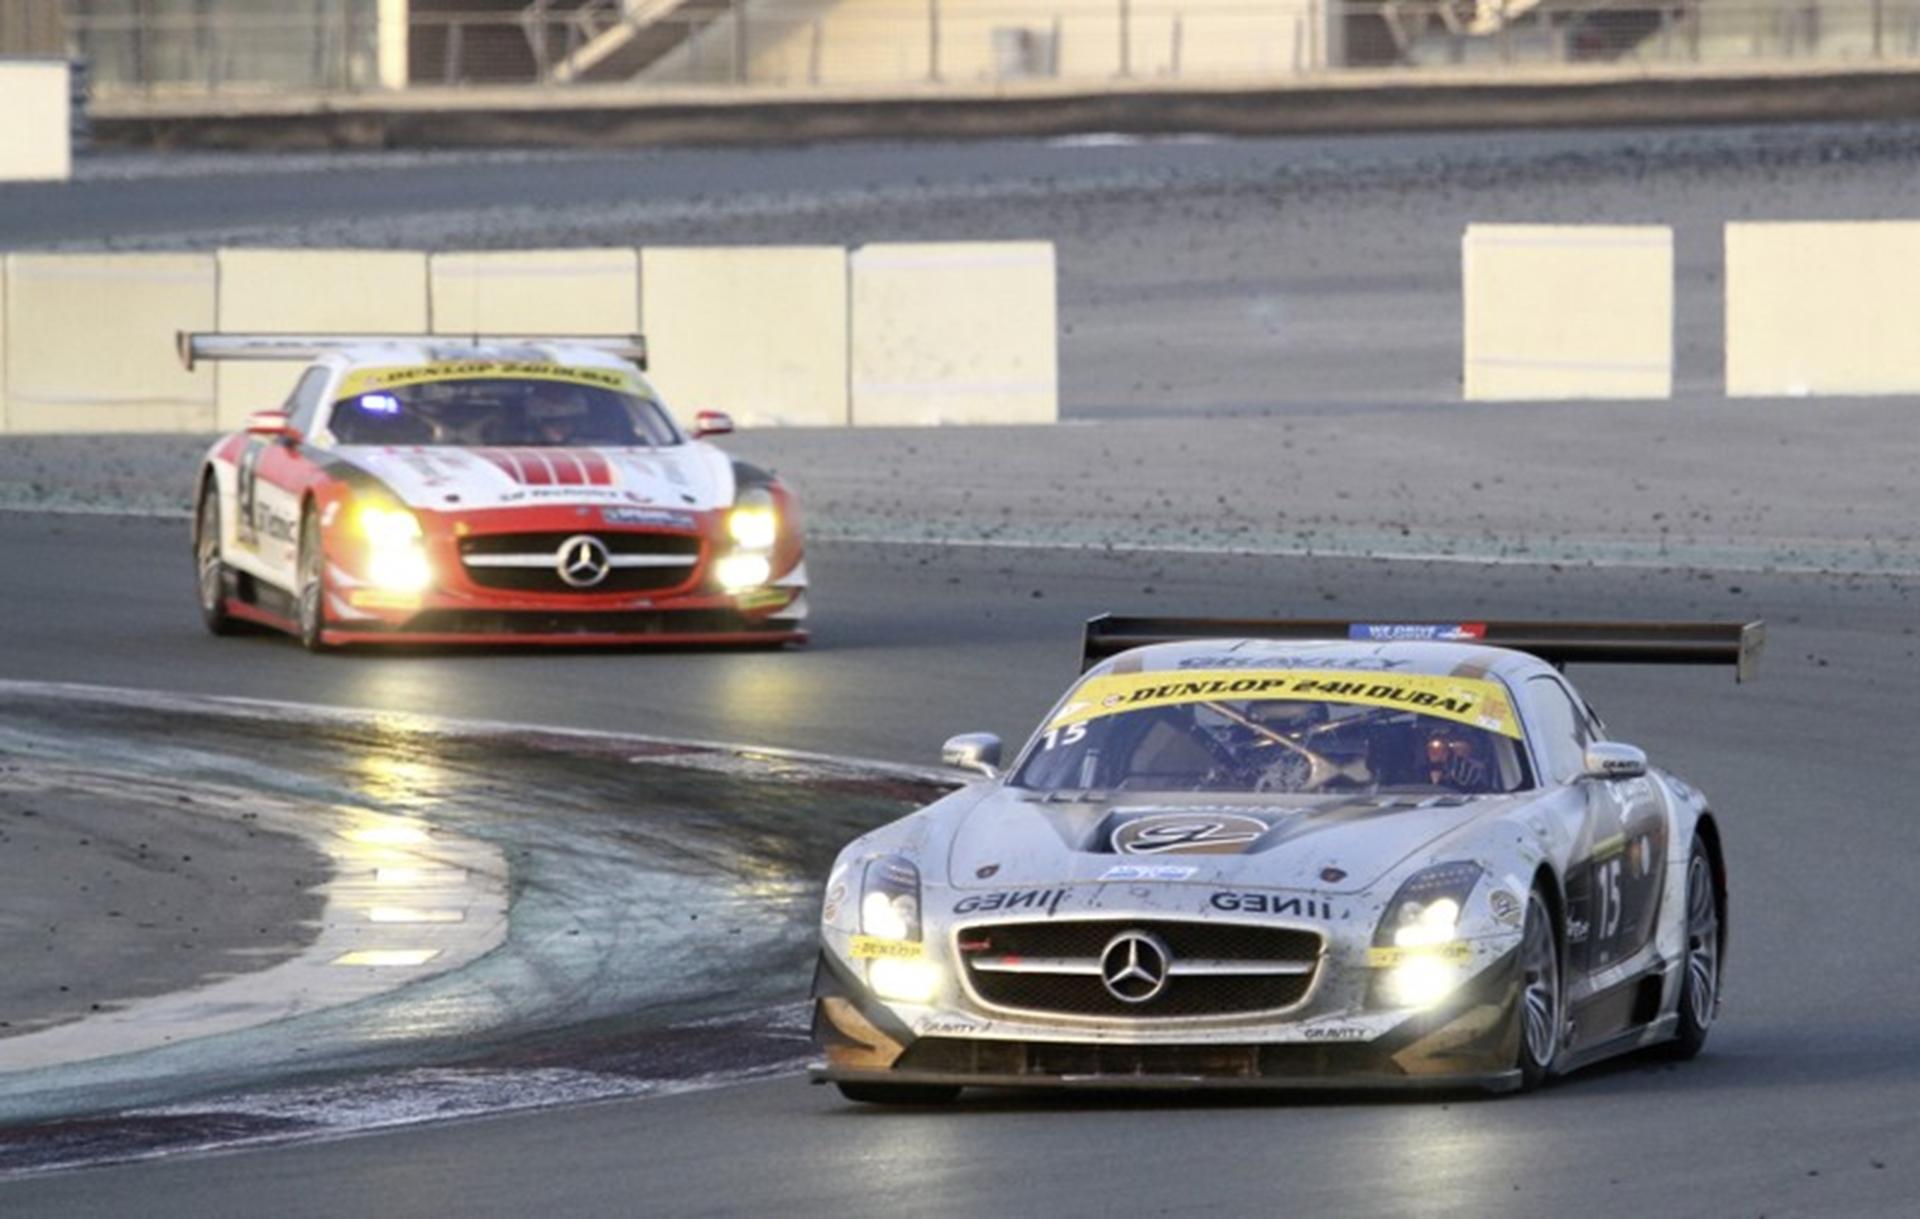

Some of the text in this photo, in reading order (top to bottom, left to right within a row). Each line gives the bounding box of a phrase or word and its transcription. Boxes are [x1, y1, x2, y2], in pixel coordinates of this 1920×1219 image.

[1123, 679, 1474, 715] DUNLOP 24H DUBAI
[1043, 720, 1089, 750] 15
[1599, 859, 1621, 940] 15
[1303, 1027, 1366, 1039] GRAVITY
